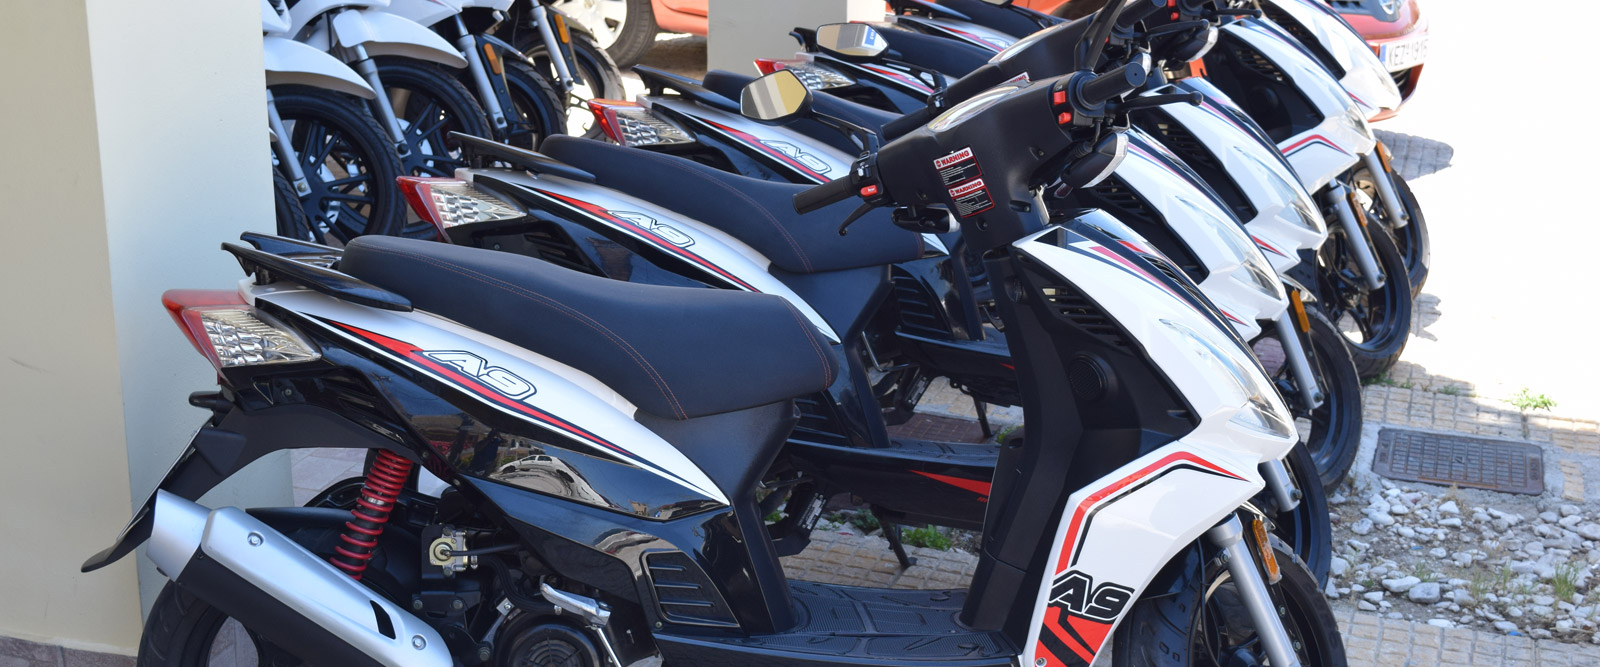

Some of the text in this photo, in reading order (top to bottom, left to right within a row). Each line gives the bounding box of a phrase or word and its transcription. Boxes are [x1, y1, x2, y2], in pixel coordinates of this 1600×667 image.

[758, 140, 832, 174] A9
[941, 150, 970, 166] WARNING
[954, 180, 982, 194] WARNING
[606, 210, 695, 248] A9
[422, 350, 537, 400] A9
[1047, 570, 1135, 624] A9
